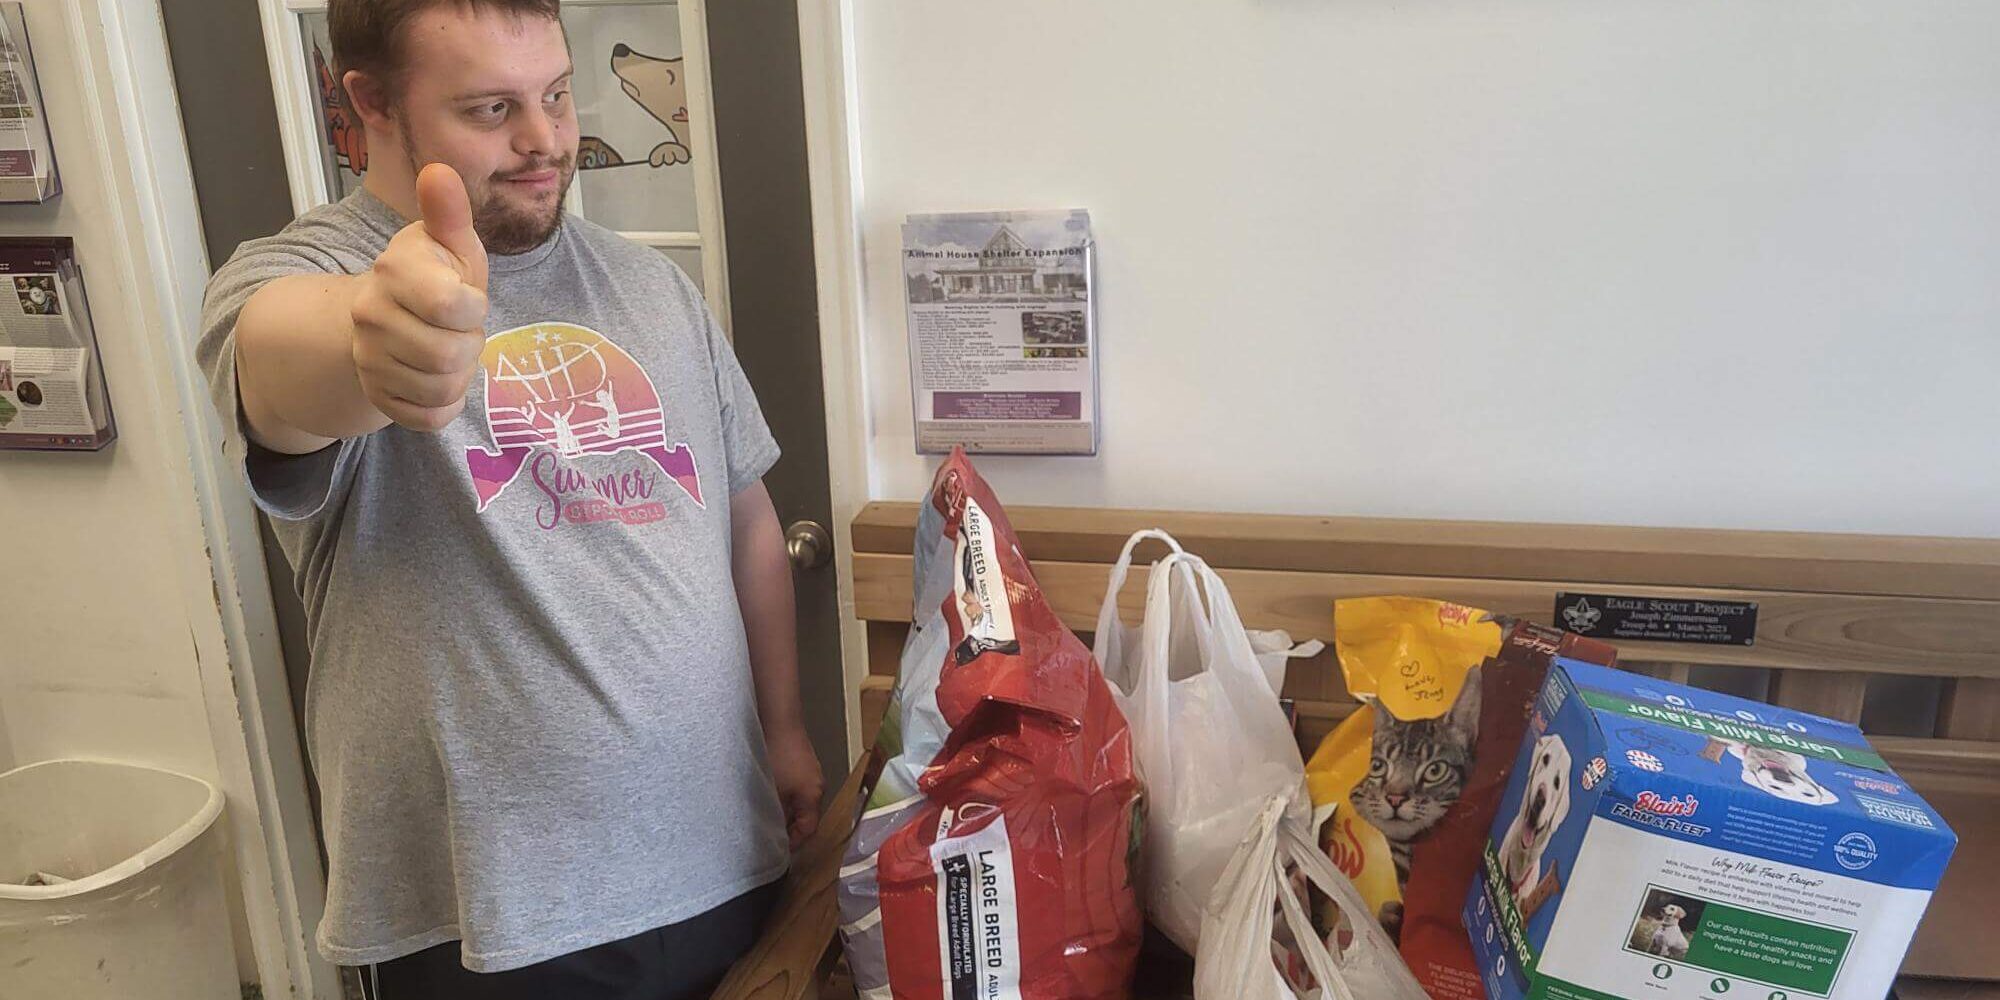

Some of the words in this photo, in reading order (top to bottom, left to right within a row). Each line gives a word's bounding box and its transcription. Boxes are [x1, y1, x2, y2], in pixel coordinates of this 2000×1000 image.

[907, 250, 943, 259] Animal
[947, 250, 979, 259] House
[983, 250, 1021, 259] Shelter
[1025, 248, 1082, 260] Expansion
[969, 505, 980, 537] LARGE
[971, 539, 986, 575] BREED
[1606, 598, 1645, 611] EAGLE
[1649, 600, 1690, 613] SCOUT
[1695, 602, 1747, 616] PROJECT
[1628, 703, 1707, 731] Flavor
[1710, 721, 1763, 743] Milk
[1769, 732, 1844, 760] Large
[1634, 790, 1699, 816] Blain's
[1611, 803, 1653, 825] FARM
[1663, 818, 1712, 837] FLEET
[1850, 848, 1879, 861] QUALITY
[978, 850, 999, 908] LARGE
[959, 876, 970, 922] SPECIALLY
[961, 923, 973, 974] FORMULATED
[984, 913, 1002, 968] BREED
[1507, 910, 1532, 968] Flavor
[1703, 930, 1746, 946] ingredients
[1748, 940, 1760, 949] for
[1760, 943, 1790, 957] healthy
[1791, 951, 1817, 962] snacks
[1818, 956, 1833, 965] and
[1706, 920, 1722, 930] Our
[1722, 925, 1738, 935] dog
[1739, 928, 1769, 941] biscuits
[1770, 935, 1799, 948] contain
[1800, 942, 1838, 956] nutritious
[1714, 943, 1733, 954] have
[1740, 949, 1760, 960] taste
[1761, 954, 1781, 965] dogs
[1782, 958, 1795, 967] will
[1796, 961, 1814, 972] love.
